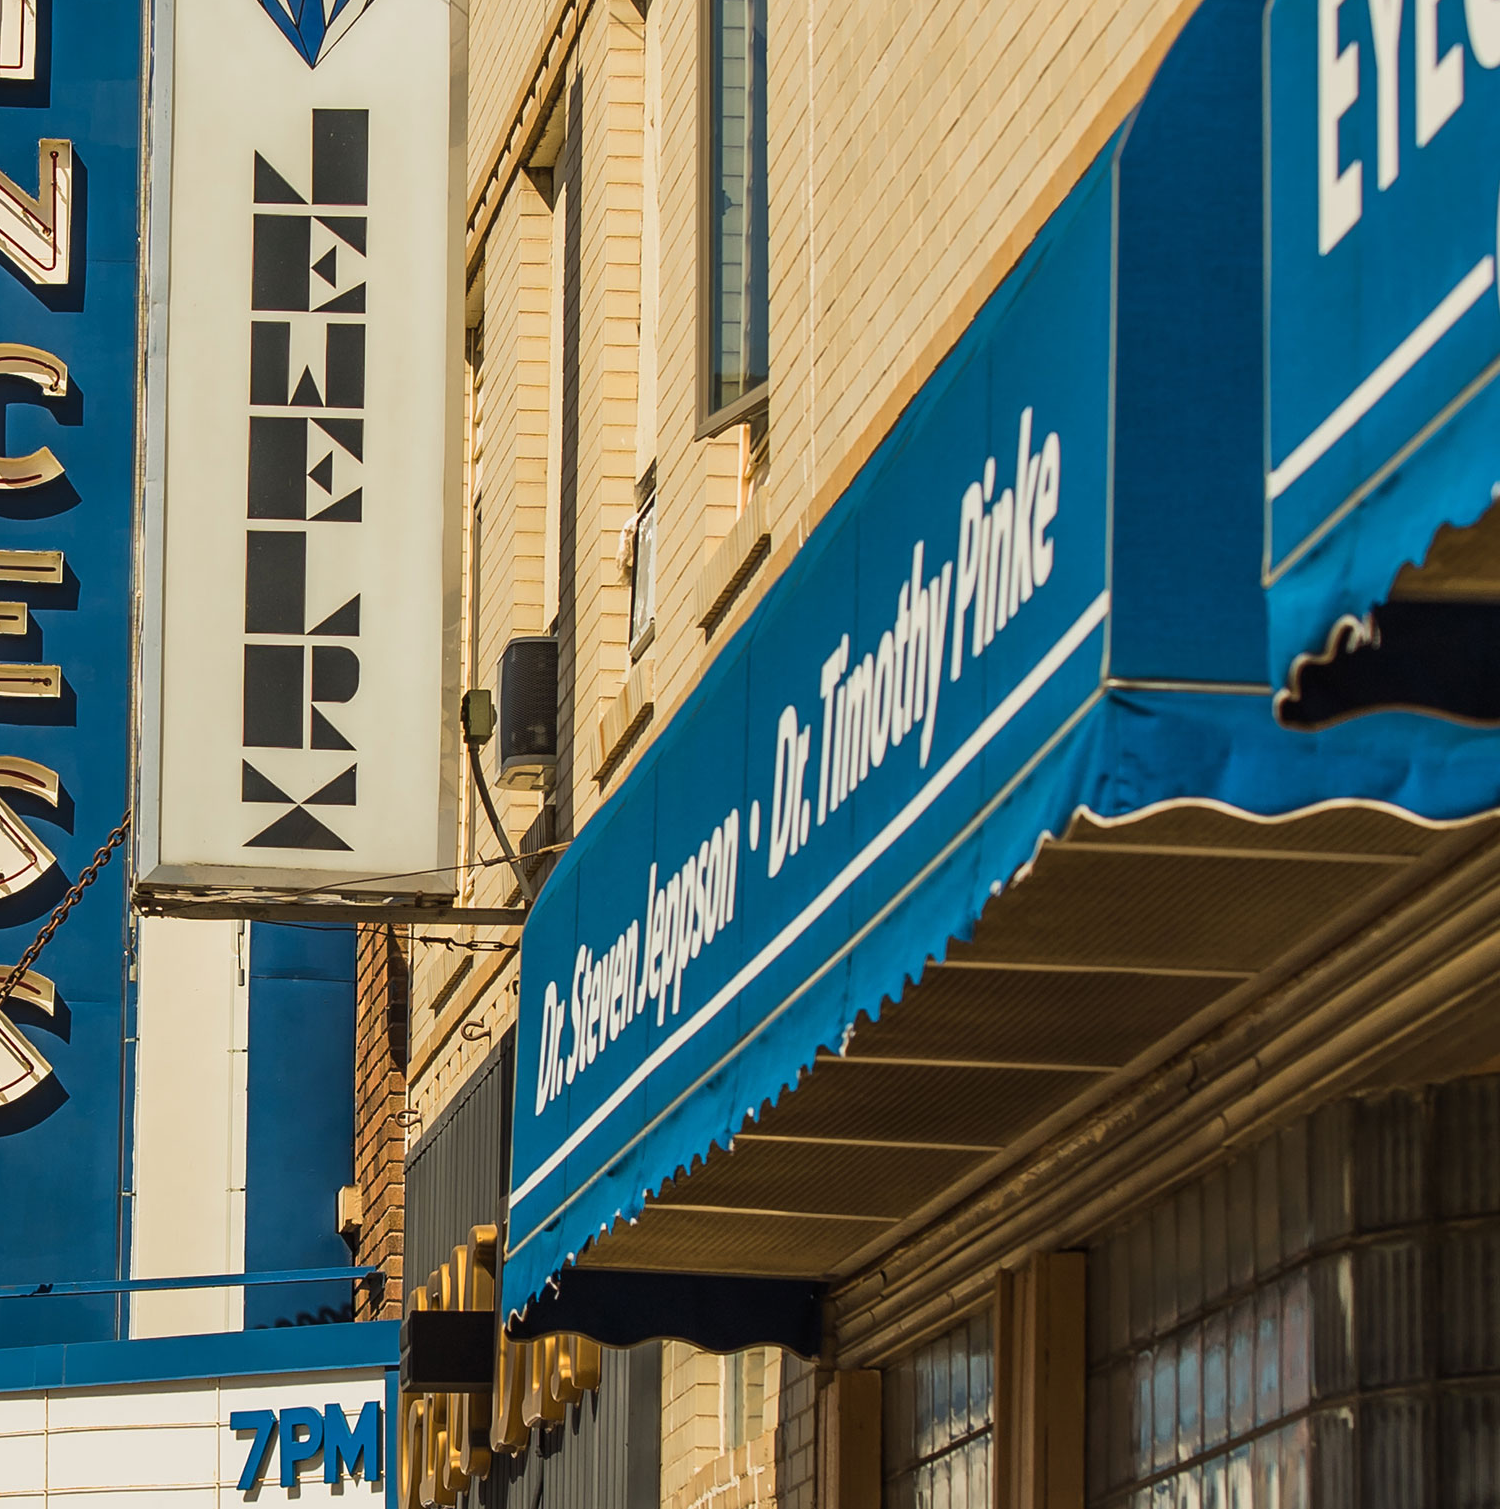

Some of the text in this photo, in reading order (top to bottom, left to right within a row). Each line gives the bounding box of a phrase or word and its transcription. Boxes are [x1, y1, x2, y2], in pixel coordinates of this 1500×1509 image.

[535, 405, 1061, 1117] Dr. Steven Jeppson Dr. Timothy Pinke
[230, 1399, 382, 1491] 7PM
